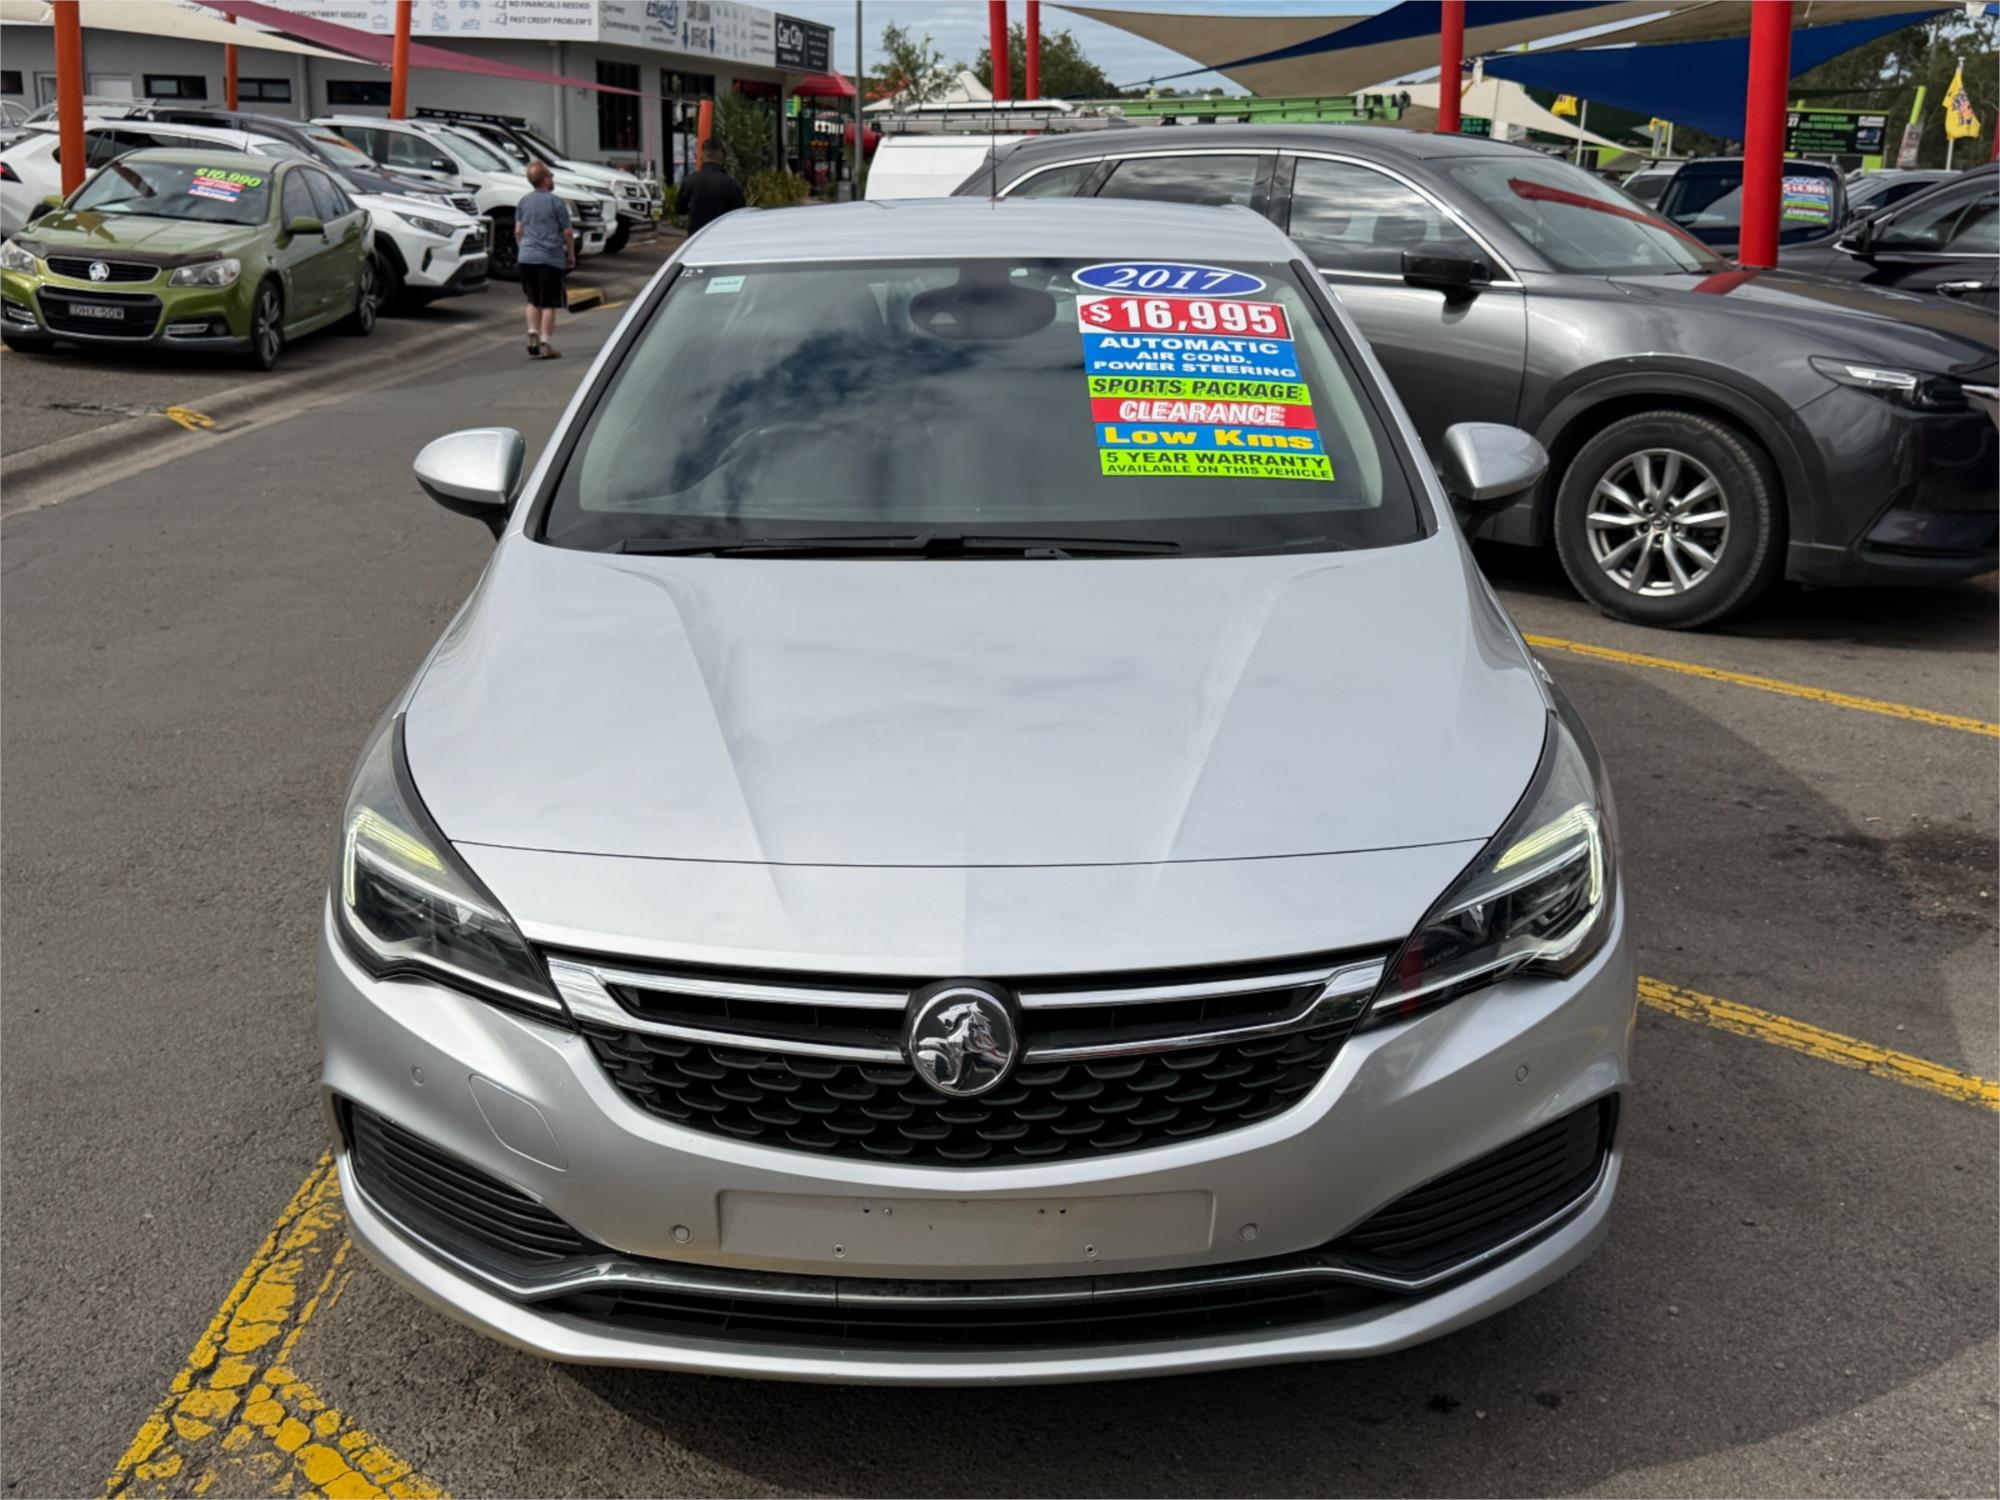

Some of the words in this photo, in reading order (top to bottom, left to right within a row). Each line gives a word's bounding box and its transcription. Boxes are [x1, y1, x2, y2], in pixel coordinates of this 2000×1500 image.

[553, 17, 592, 26] PROBLEM'S
[1104, 268, 1234, 291] 2017
[1089, 300, 1277, 335] $16,995
[1099, 336, 1280, 355] AUTOMATIC
[1136, 351, 1175, 361] AIR
[1182, 352, 1252, 364] COND.
[1093, 360, 1175, 372] POWER
[1182, 362, 1297, 378] STEERING
[1092, 379, 1184, 394] SPORTS
[1192, 381, 1301, 400] PACKAGE
[1119, 400, 1286, 426] CLEARANCE
[1104, 426, 1198, 445] Low
[1214, 429, 1314, 449] Kms
[1107, 452, 1119, 463] 5
[1126, 452, 1188, 464] YEAR
[1193, 453, 1326, 468] WARRANTY
[1107, 464, 1192, 474] AVAILABLE
[1197, 465, 1219, 474] ON
[1224, 466, 1259, 475] THIS
[1264, 467, 1330, 479] VEHICLE
